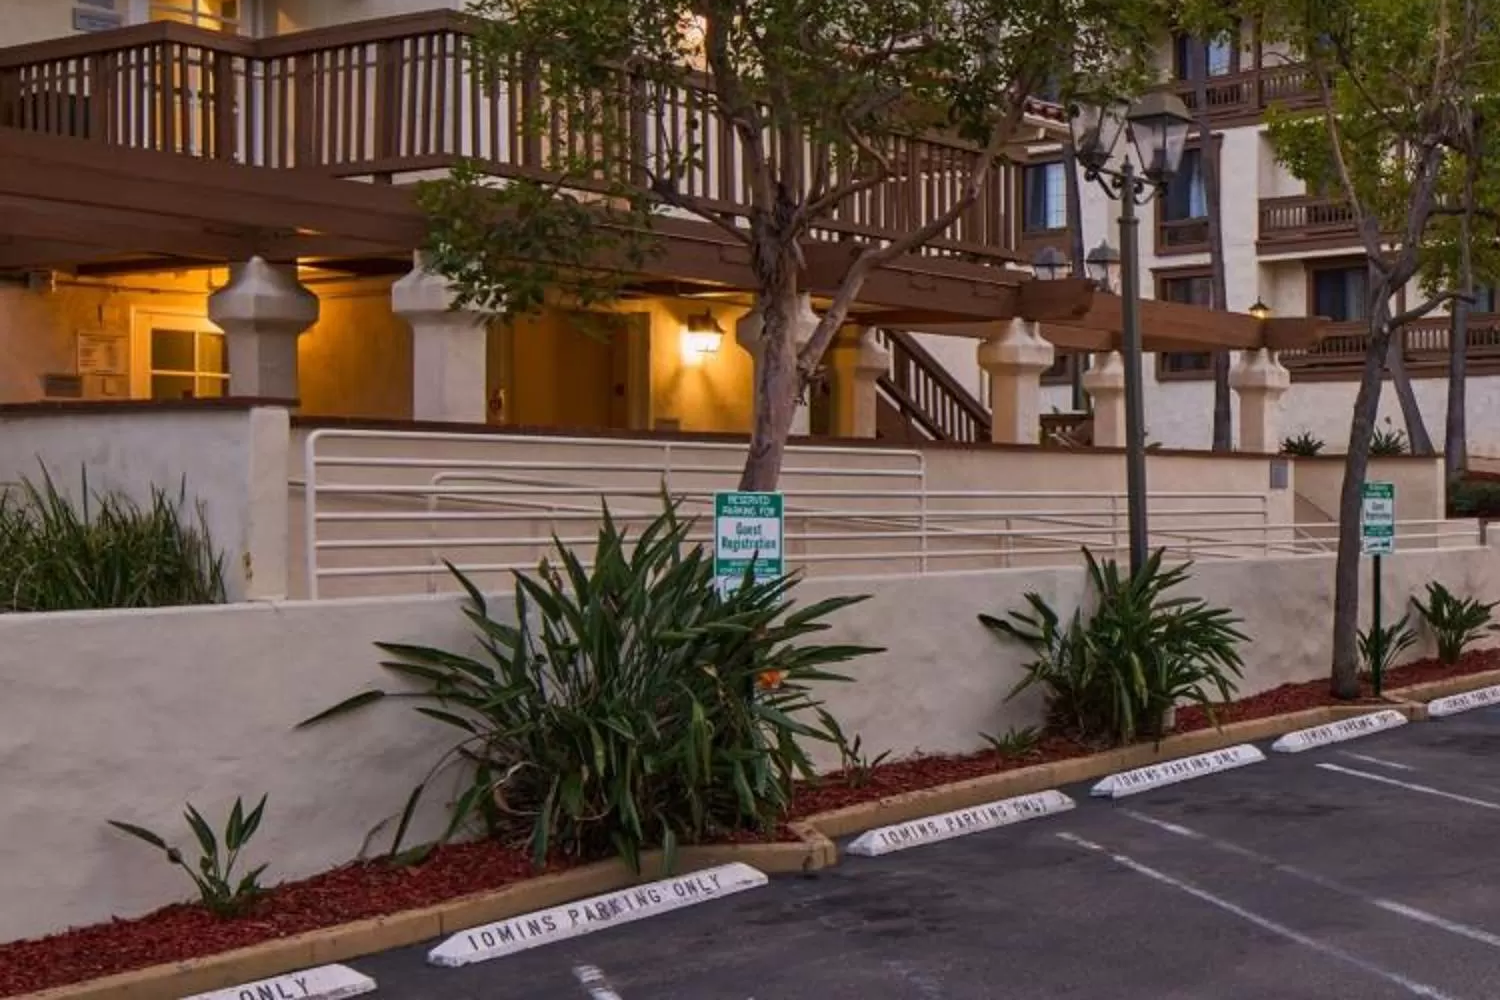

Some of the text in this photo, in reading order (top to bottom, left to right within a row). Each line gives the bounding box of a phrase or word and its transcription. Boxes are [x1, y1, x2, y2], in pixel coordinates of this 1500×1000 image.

[759, 506, 776, 517] FOR
[735, 521, 762, 535] Guest
[721, 536, 776, 552] Registration
[944, 804, 1007, 831] PARKING
[567, 889, 661, 928] PARKING
[672, 873, 721, 897] ONLY
[240, 977, 308, 1000] ONLY
